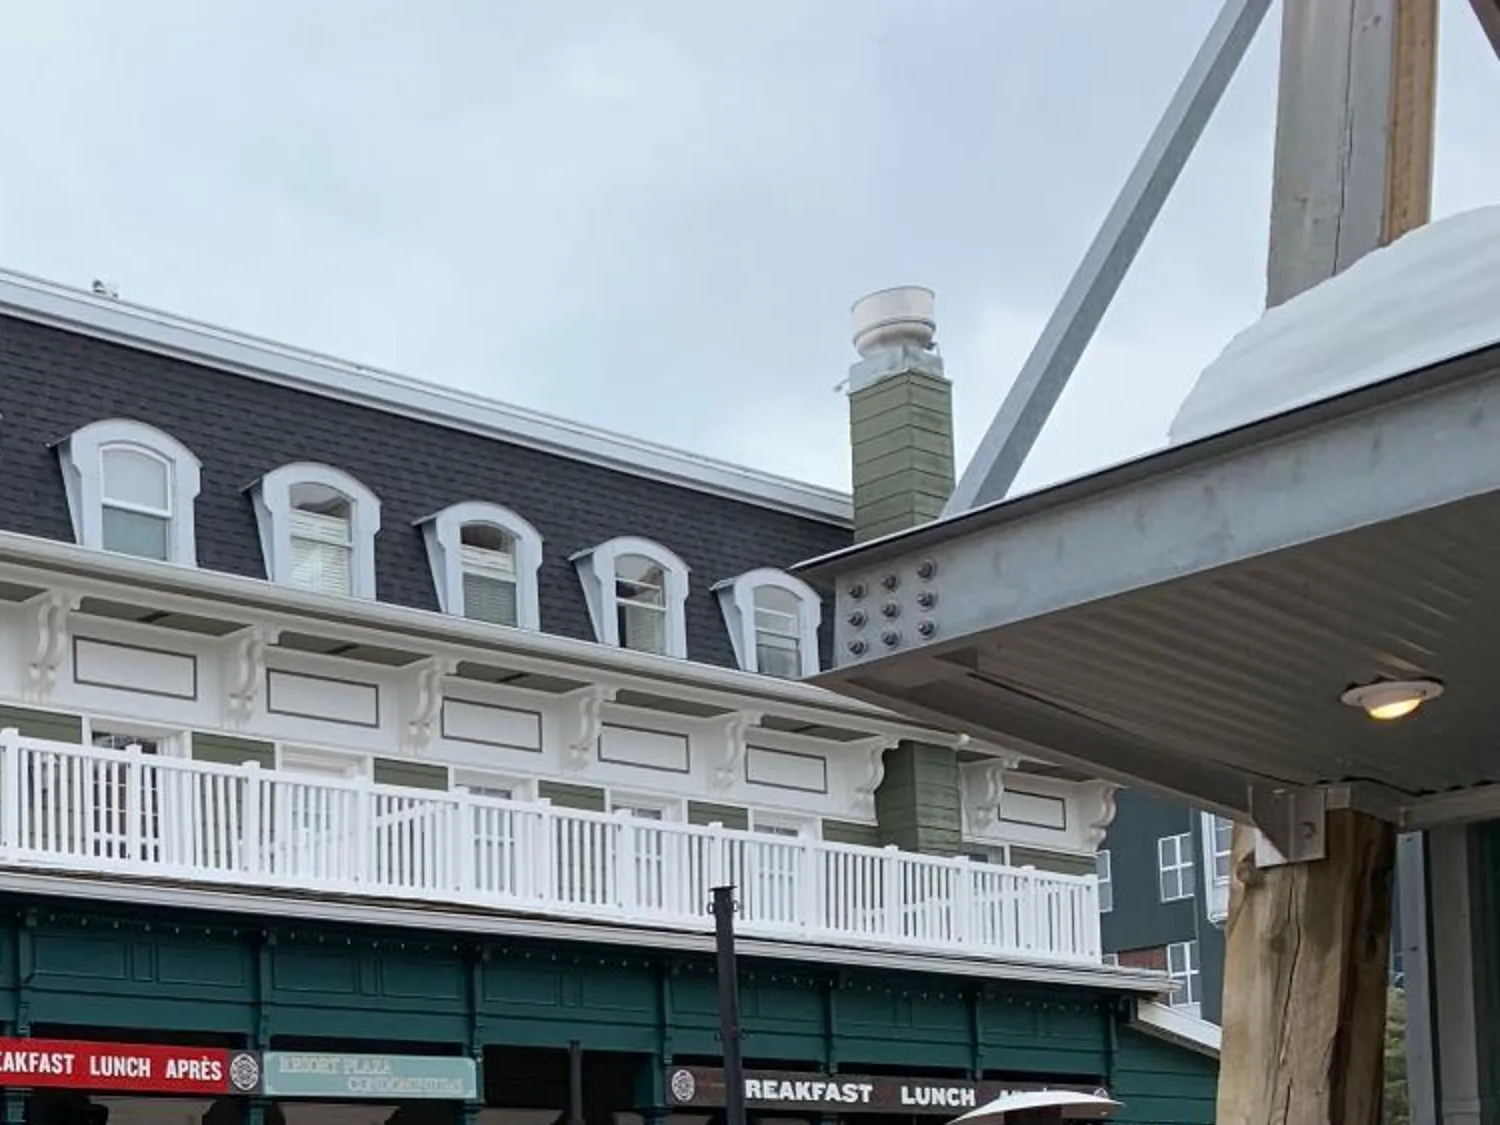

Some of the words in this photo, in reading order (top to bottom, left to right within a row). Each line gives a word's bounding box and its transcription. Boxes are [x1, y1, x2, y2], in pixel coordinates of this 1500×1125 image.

[89, 1055, 151, 1078] LUNCH
[165, 1056, 223, 1081] APRÈS
[744, 1079, 874, 1103] REAKFAST
[901, 1085, 977, 1107] LUNCH
